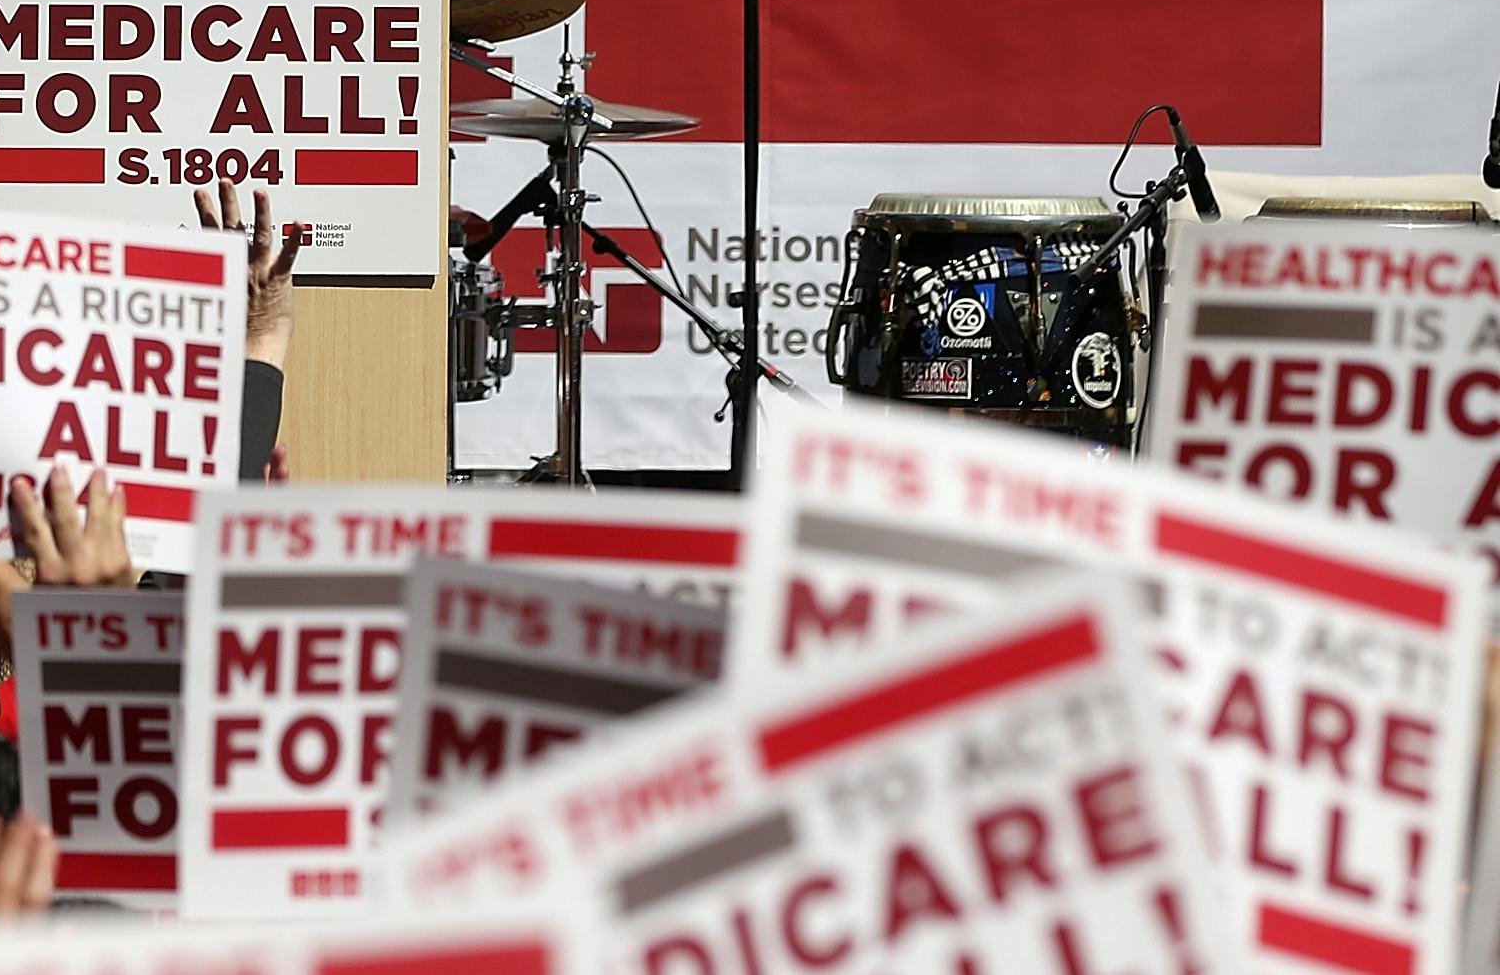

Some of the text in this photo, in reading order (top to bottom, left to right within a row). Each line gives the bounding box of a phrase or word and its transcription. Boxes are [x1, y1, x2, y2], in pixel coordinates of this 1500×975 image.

[210, 74, 419, 134] ALL!
[118, 148, 282, 185] S.1804
[316, 223, 351, 231] National
[1196, 243, 1500, 301] HEALTHCA
[31, 285, 61, 318] A
[82, 289, 225, 333] RIGHT!
[1392, 307, 1446, 353] IS
[1184, 352, 1500, 439] MEDIC
[38, 401, 218, 475] ALL!
[957, 459, 1127, 543] TIME
[220, 514, 466, 559] IT'S TIME
[37, 612, 129, 650] IT'S
[436, 586, 551, 647] IT'S
[574, 602, 726, 683] TIME
[48, 776, 179, 841] FO
[640, 763, 1165, 975] DICARE
[1192, 767, 1428, 916] LL!
